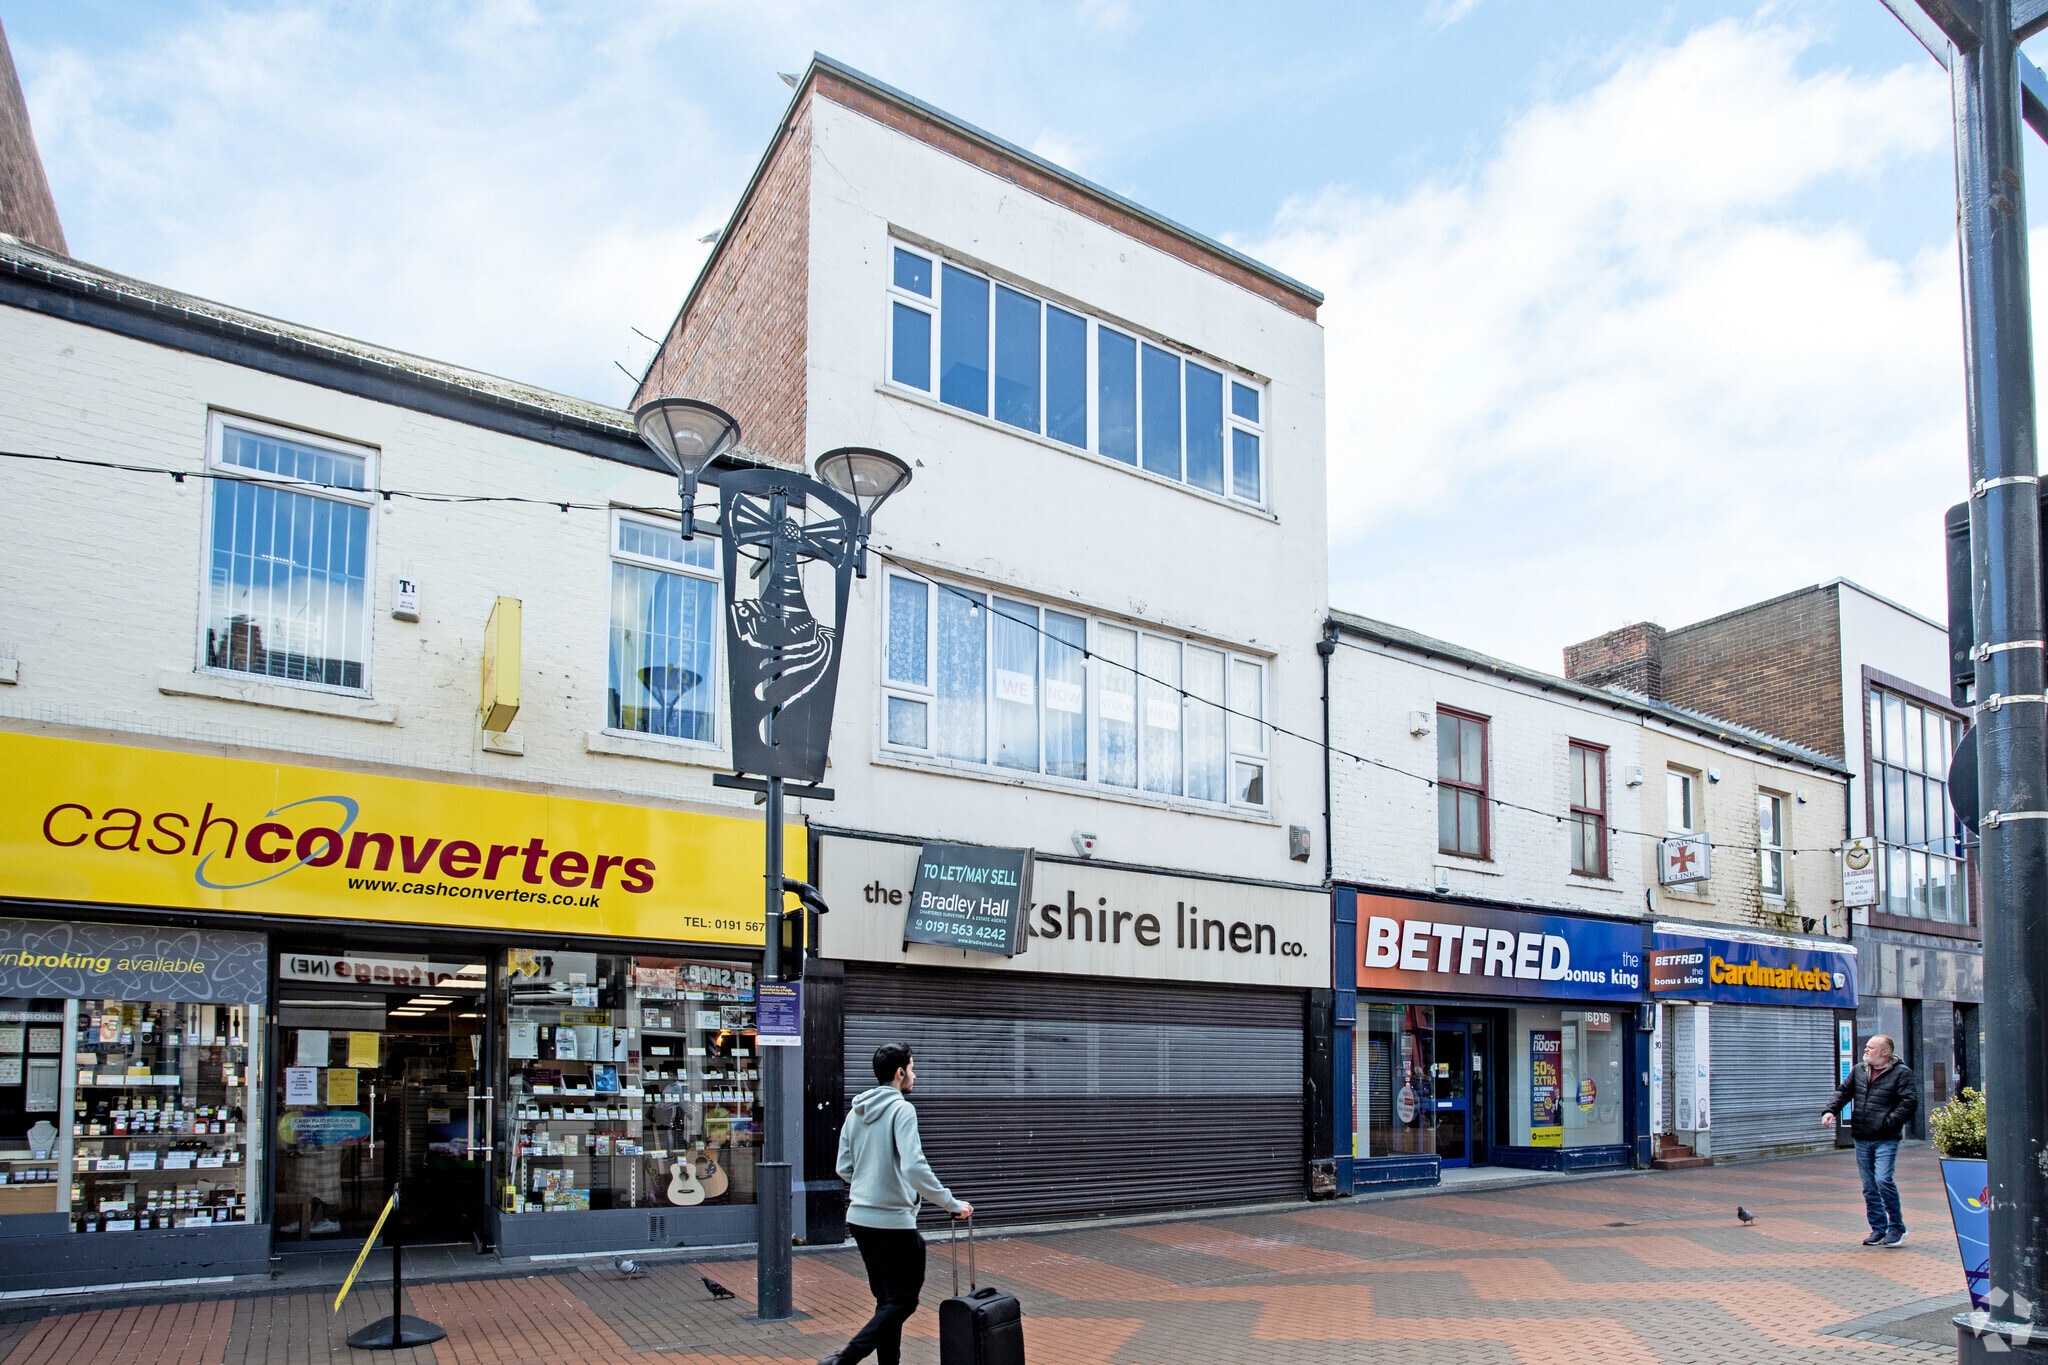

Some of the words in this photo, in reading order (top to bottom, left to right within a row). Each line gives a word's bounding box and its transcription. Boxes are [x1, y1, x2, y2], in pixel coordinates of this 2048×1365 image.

[1002, 678, 1028, 697] WE
[1047, 687, 1081, 704] NOW
[924, 864, 938, 879] TO
[940, 865, 990, 884] LET/MAY
[990, 869, 1017, 886] SELL
[1668, 871, 1699, 881] CLINIC
[348, 877, 600, 909] www.cashconverters.co.uk
[919, 909, 942, 917] CHARTERED
[920, 891, 976, 919] Bradley
[979, 897, 1010, 917] Hall
[684, 916, 711, 929] TEL:
[714, 918, 741, 931] 0191
[745, 921, 765, 932] 567
[863, 881, 900, 905] the
[1177, 902, 1277, 954] linen
[1281, 941, 1307, 958] co.
[925, 920, 949, 933] 0191
[951, 923, 973, 937] 563
[976, 926, 1006, 941] 4242
[957, 938, 1005, 948] www.bradleyhall.co.uk
[1365, 916, 1570, 982] BETFRED
[117, 957, 205, 974] available
[1622, 951, 1639, 968] the
[1655, 953, 1703, 966] BETFRED
[1564, 967, 1606, 986] bonus
[1611, 968, 1639, 989] king
[1692, 967, 1703, 976] the
[1710, 955, 1832, 991] Cardmarkets
[1684, 976, 1704, 985] king
[1533, 1061, 1555, 1075] 50%
[1533, 1075, 1557, 1086] EXTRA
